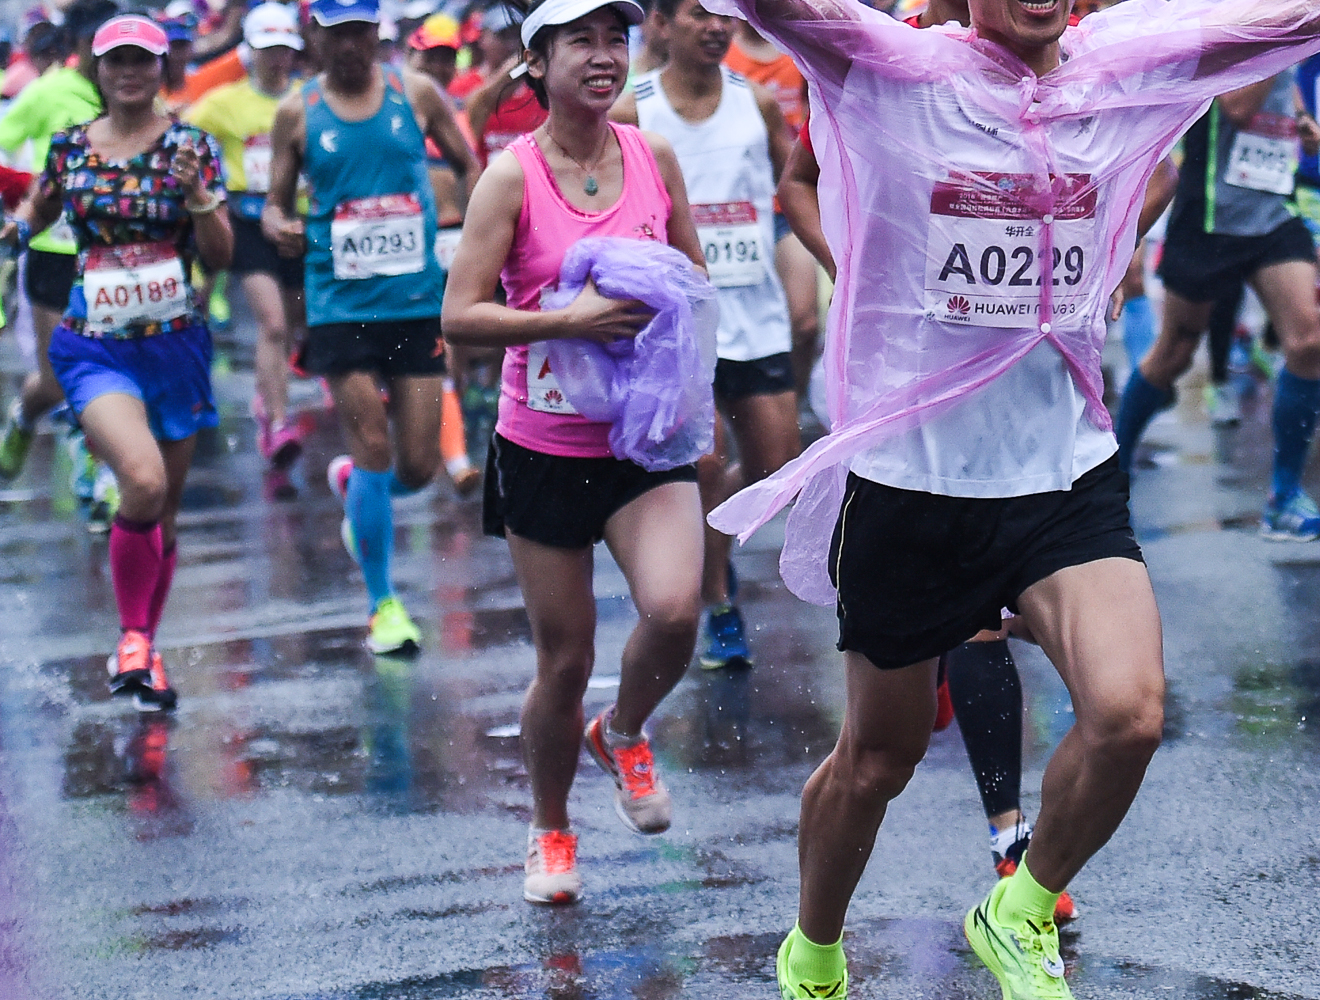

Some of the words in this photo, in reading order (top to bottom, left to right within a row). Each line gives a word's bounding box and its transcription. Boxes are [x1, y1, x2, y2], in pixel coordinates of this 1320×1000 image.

[1005, 225, 1036, 238] 华开全
[341, 231, 417, 258] A0293
[704, 240, 760, 264] 0192
[937, 242, 1085, 287] A0229
[94, 277, 178, 310] A0189
[974, 302, 1030, 315] HUAWEI
[1069, 303, 1076, 314] 3
